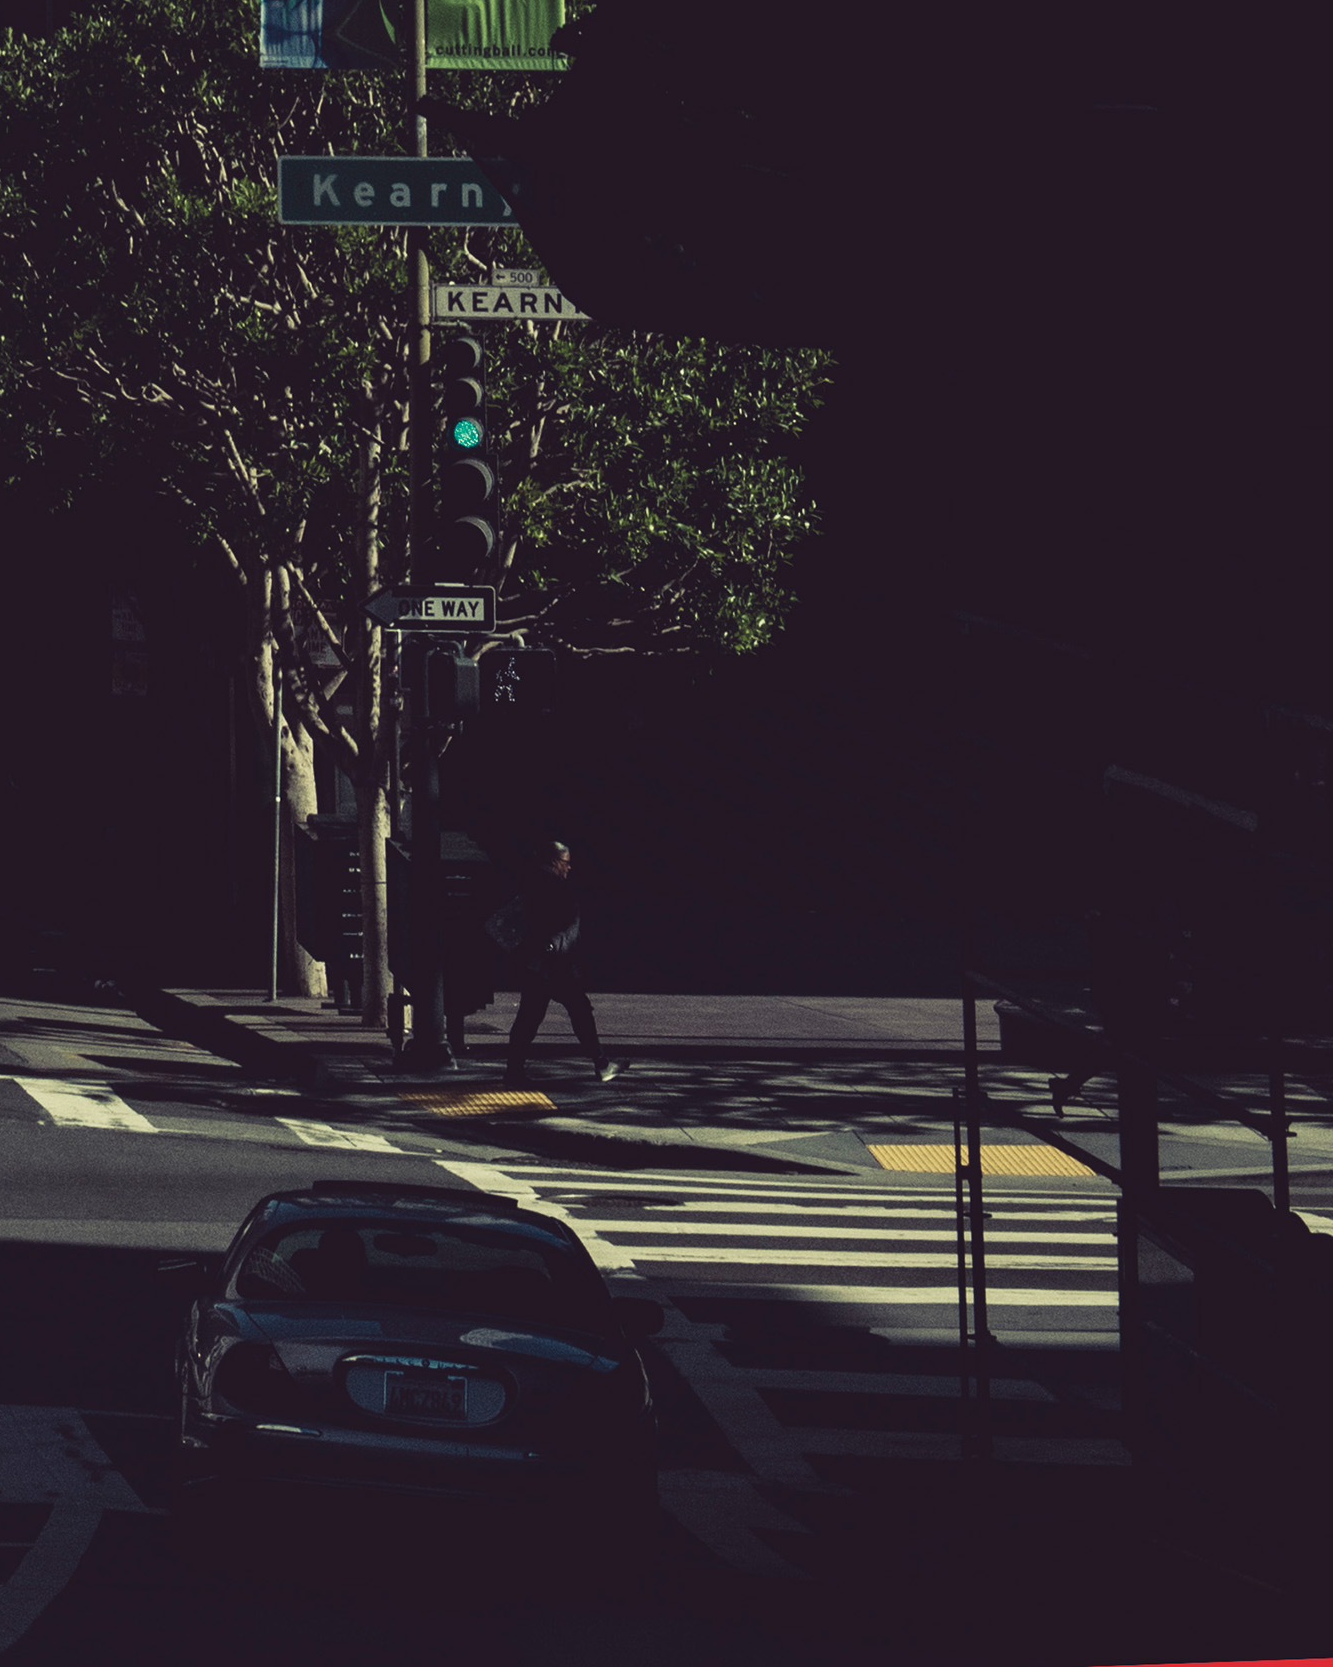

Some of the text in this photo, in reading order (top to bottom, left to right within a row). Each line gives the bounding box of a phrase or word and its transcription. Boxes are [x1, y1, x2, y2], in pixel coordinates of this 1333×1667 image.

[509, 272, 533, 284] 500
[447, 291, 582, 314] KEARN
[398, 598, 479, 619] ONE WAY
